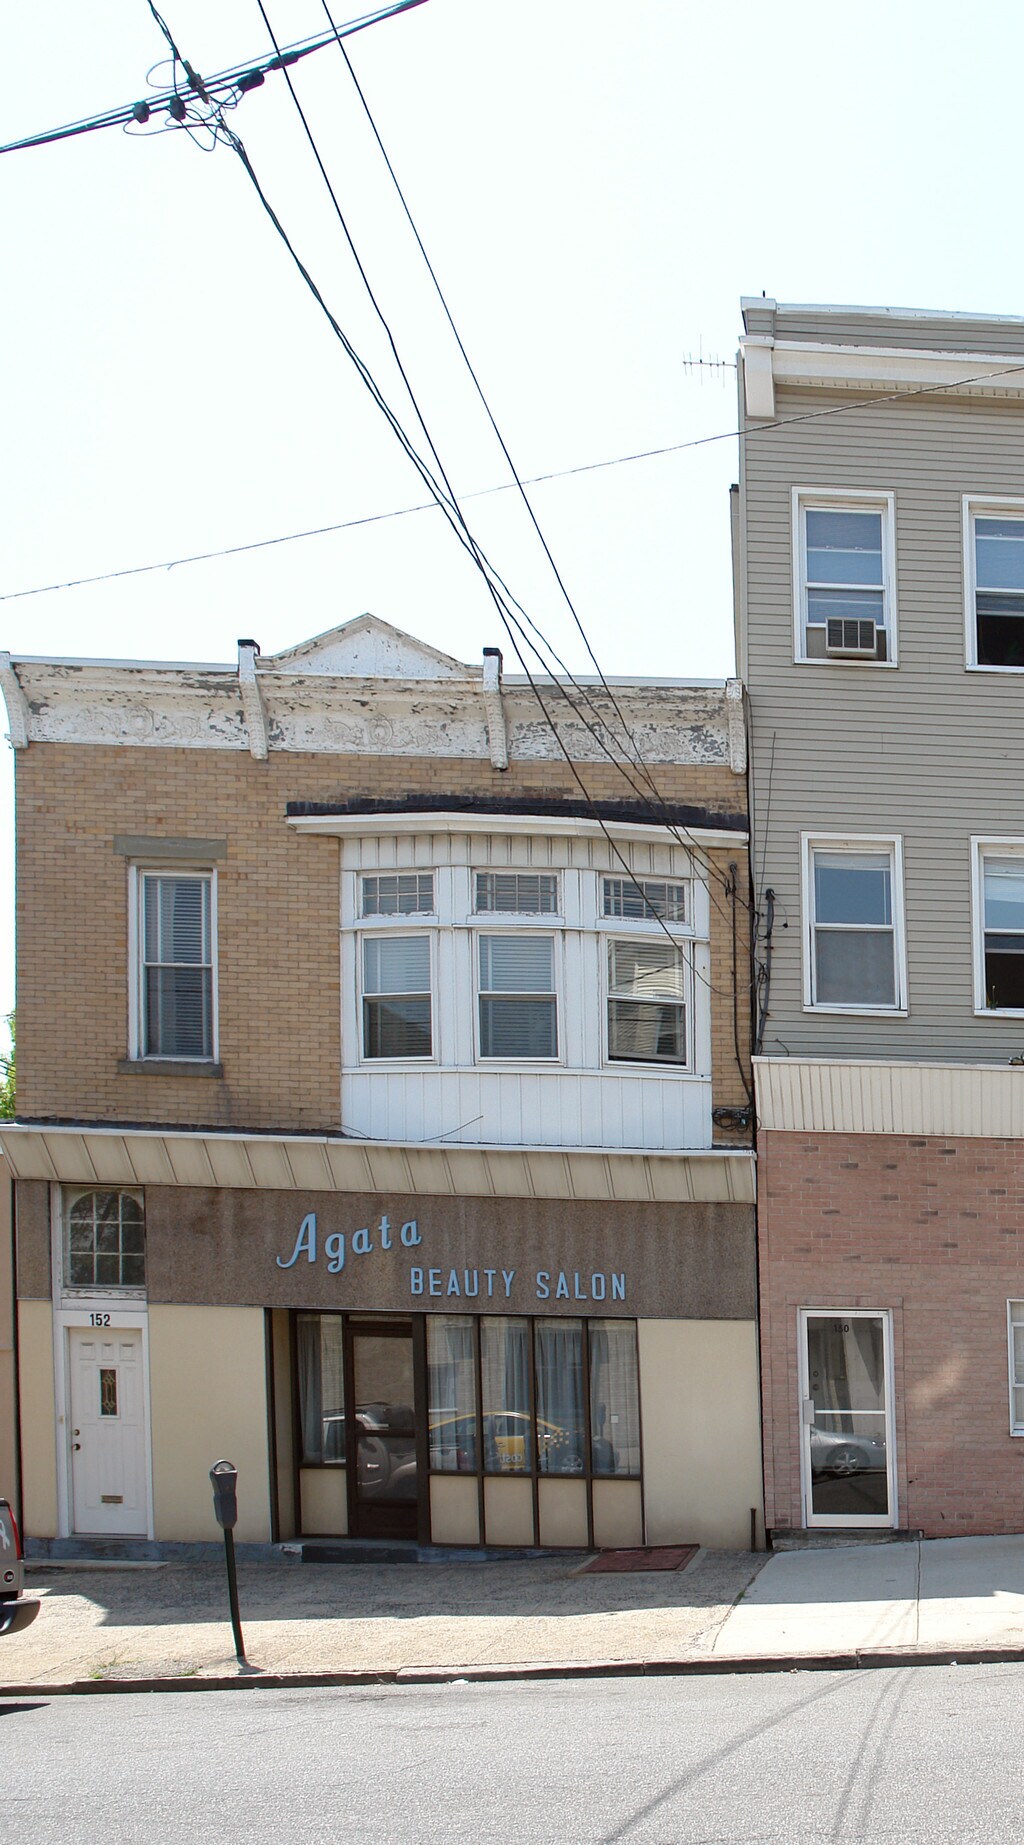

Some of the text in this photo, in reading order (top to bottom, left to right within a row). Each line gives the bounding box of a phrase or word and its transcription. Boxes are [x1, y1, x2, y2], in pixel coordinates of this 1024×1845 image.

[276, 1212, 422, 1274] Agata
[411, 1267, 626, 1301] BEAUTY SALON
[90, 1313, 111, 1327] 152
